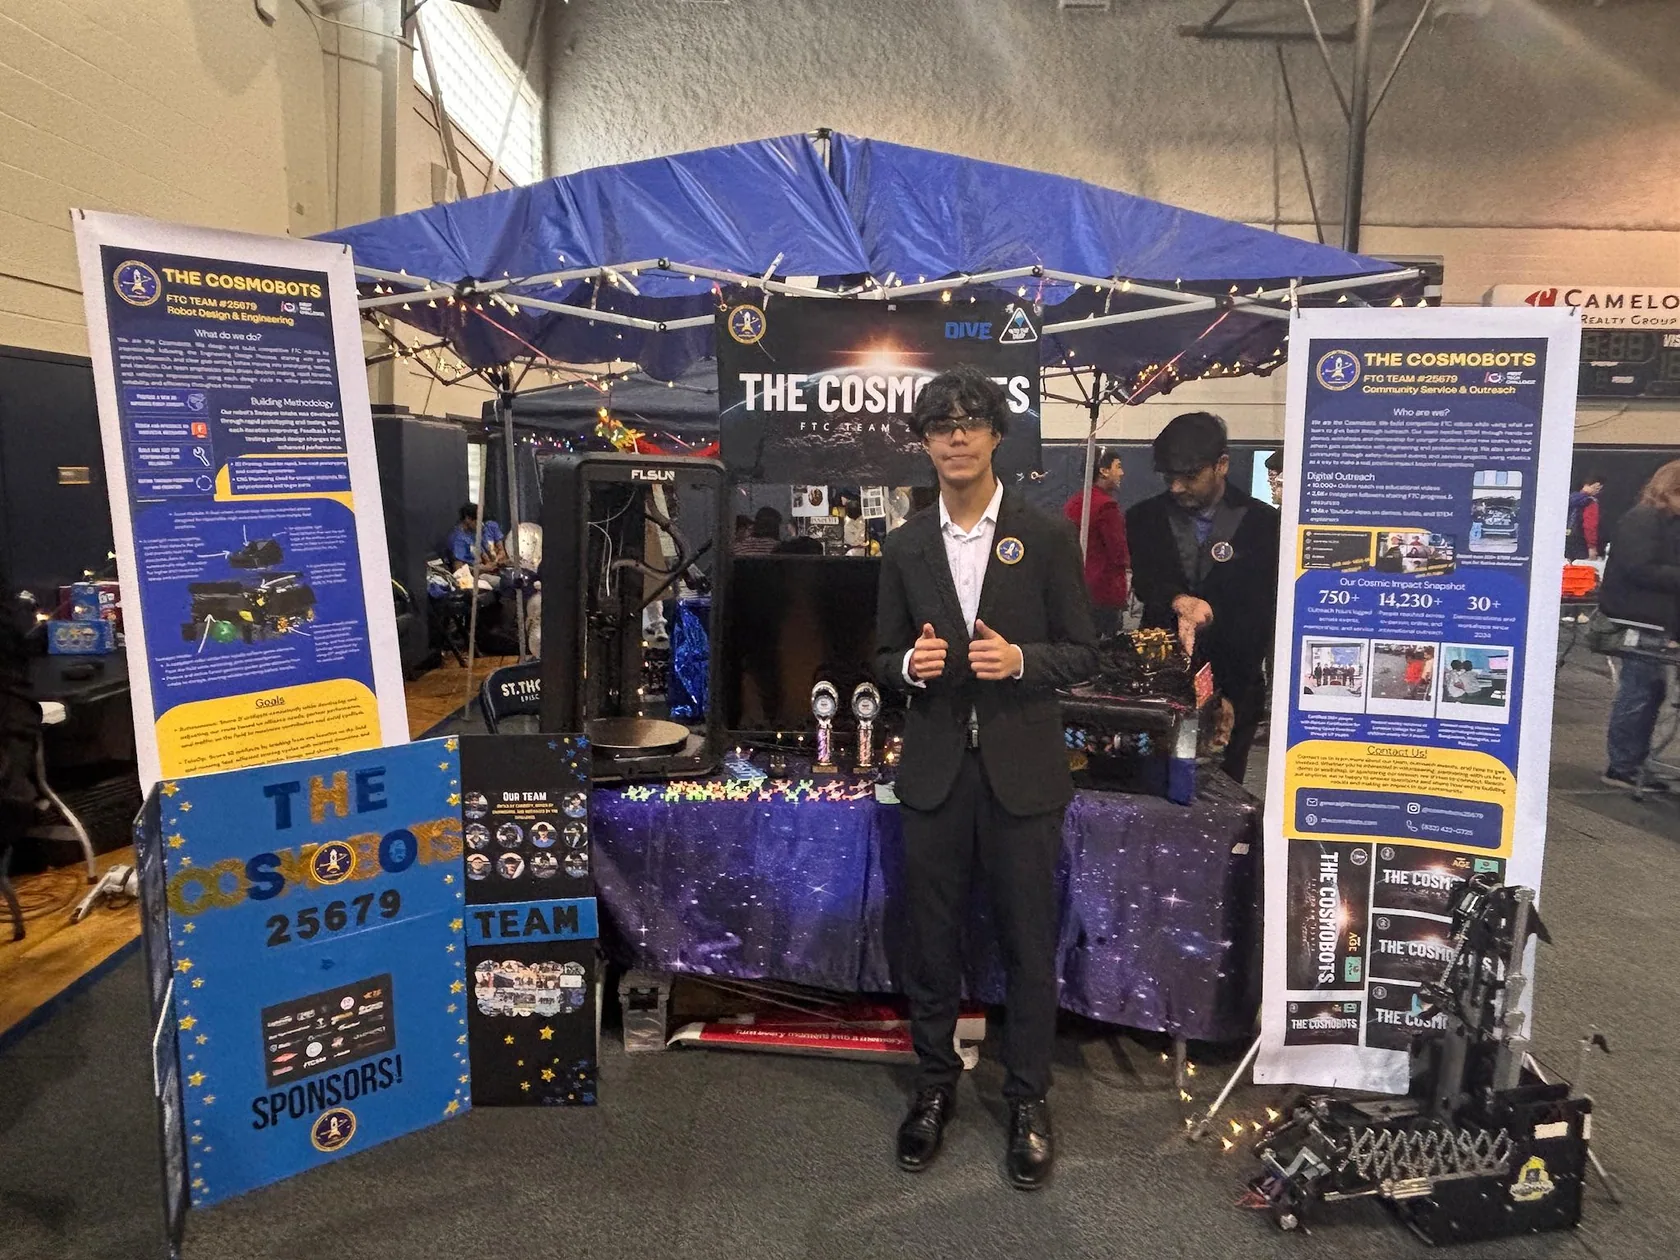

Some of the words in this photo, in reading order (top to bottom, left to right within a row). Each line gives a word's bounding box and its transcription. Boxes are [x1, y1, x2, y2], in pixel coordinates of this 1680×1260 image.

[162, 268, 200, 286] THE
[205, 273, 322, 299] COSMOBOTS
[166, 294, 187, 304] FTC
[189, 296, 217, 307] TEAM
[219, 299, 258, 311] #25679
[167, 305, 197, 317] Robot
[198, 308, 231, 321] Design
[232, 312, 240, 320] &
[240, 312, 295, 327] Engineering
[1631, 314, 1677, 326] GROUP
[193, 329, 218, 340] What
[219, 330, 231, 340] do
[232, 333, 245, 341] we
[246, 332, 262, 342] do?
[944, 321, 992, 341] DIVE
[1363, 352, 1402, 367] THE
[1405, 352, 1537, 368] COSMOBOTS
[1362, 375, 1384, 383] FTC
[1385, 375, 1416, 383] TEAM
[1416, 374, 1458, 384] #25679
[739, 373, 808, 412] THE
[1362, 385, 1420, 395] Community
[1420, 385, 1457, 394] Service
[1458, 385, 1468, 394] &
[1469, 385, 1516, 395] Outreach
[251, 397, 283, 408] Building
[283, 398, 334, 410] Methodology
[1393, 408, 1414, 417] Who
[1415, 409, 1431, 417] are
[1431, 408, 1450, 417] we?
[800, 422, 830, 432] FTC
[844, 423, 891, 433] TEAM
[631, 469, 675, 481] FLSUN
[1307, 471, 1334, 482] Digital
[1335, 472, 1375, 482] Outreach
[1339, 578, 1356, 586] Our
[1358, 578, 1391, 588] Cosmic
[1392, 580, 1423, 590] Impact
[1424, 582, 1466, 592] Snapshot
[1318, 589, 1361, 605] 750+
[1378, 592, 1444, 609] 14,230+
[1467, 595, 1502, 611] 30+
[255, 696, 286, 709] Goals
[1366, 745, 1409, 756] Contact
[1410, 748, 1428, 758] Us!
[263, 765, 389, 830] THE
[502, 791, 520, 802] OUR
[522, 791, 547, 802] TEAM
[1319, 852, 1339, 883] THE
[1382, 869, 1410, 884] THE
[265, 888, 402, 949] 25679
[474, 904, 579, 940] TEAM
[1317, 887, 1338, 984] COSMOBOTS
[1378, 939, 1406, 955] THE
[1291, 1019, 1309, 1030] THE
[1308, 1018, 1359, 1030] COSMOBOTS
[1375, 1008, 1402, 1025] THE
[251, 1054, 404, 1131] SPONSORS!
